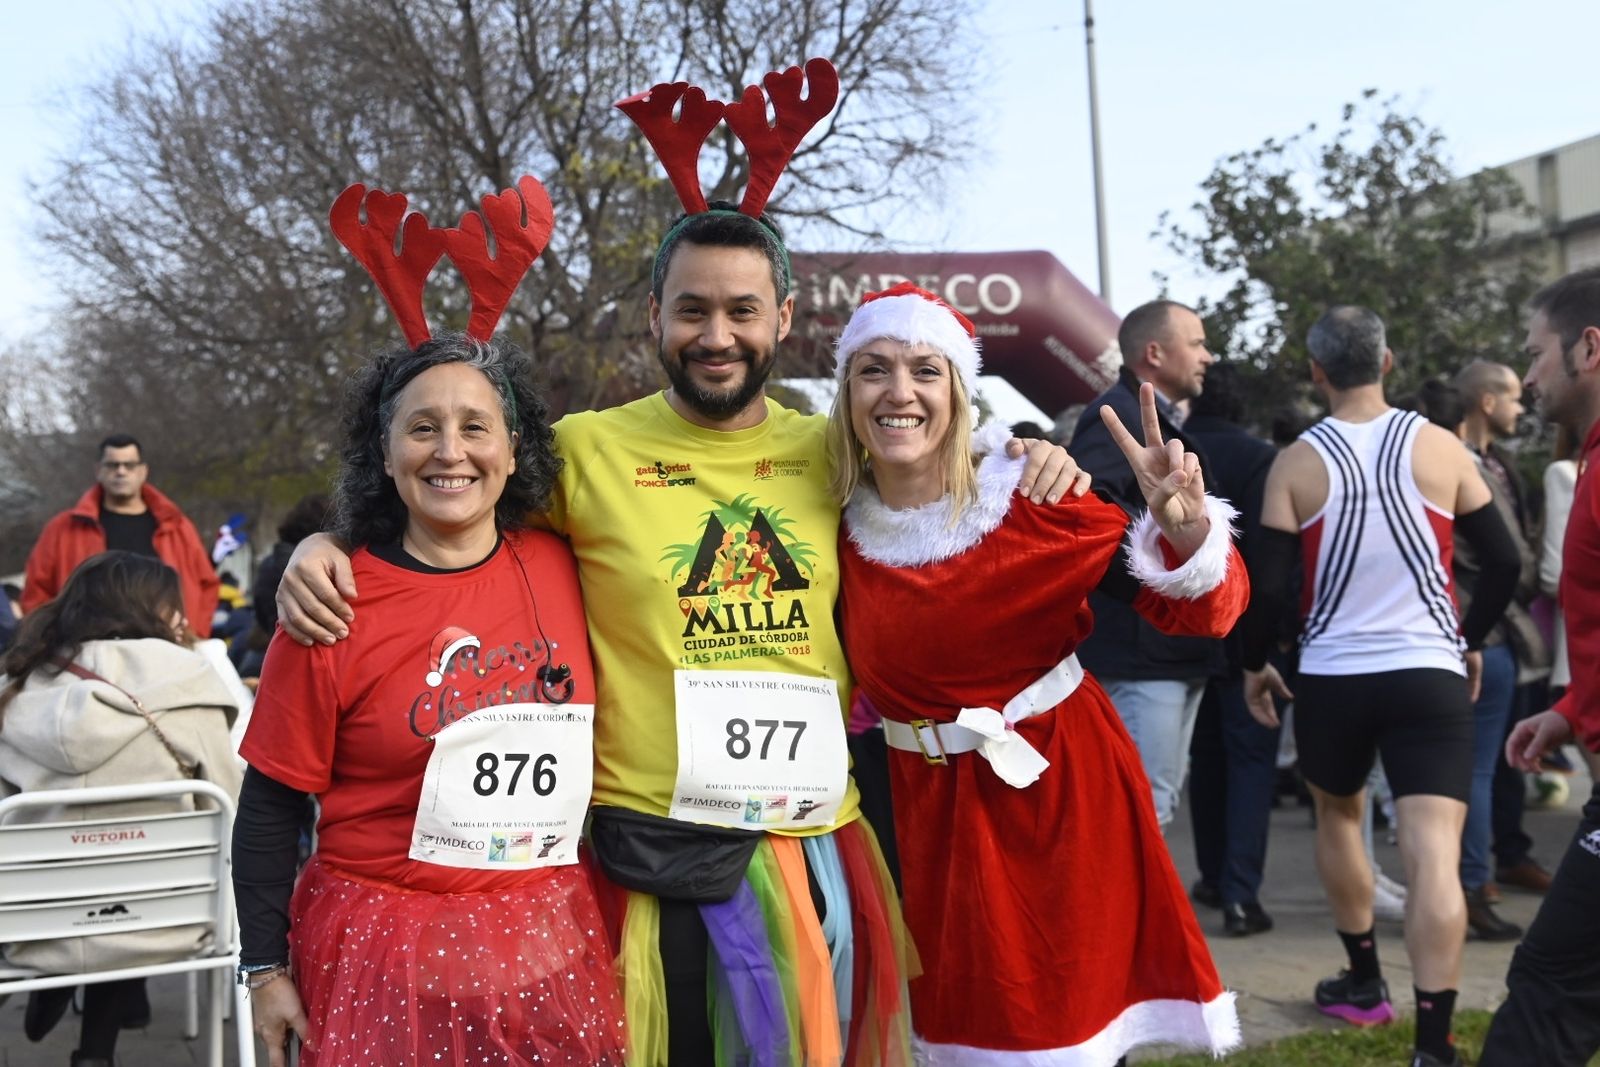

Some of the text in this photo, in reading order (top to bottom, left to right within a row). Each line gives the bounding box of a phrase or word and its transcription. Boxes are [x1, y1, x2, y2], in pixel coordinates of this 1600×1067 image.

[682, 599, 810, 638] MILLA
[684, 631, 810, 651] CIUDAD DE CÓRDOBA
[685, 644, 811, 665] LAS PALMERAS 2018
[703, 680, 723, 689] SAN
[725, 680, 780, 690] SILVESTRE
[781, 681, 832, 696] CORDOBESA
[483, 713, 535, 722] SILVESTRE
[725, 718, 807, 760] 877
[473, 752, 558, 797] 876
[693, 798, 741, 809] IMDECO
[71, 831, 145, 843] VICTORIA
[434, 836, 485, 851] IMDECO
